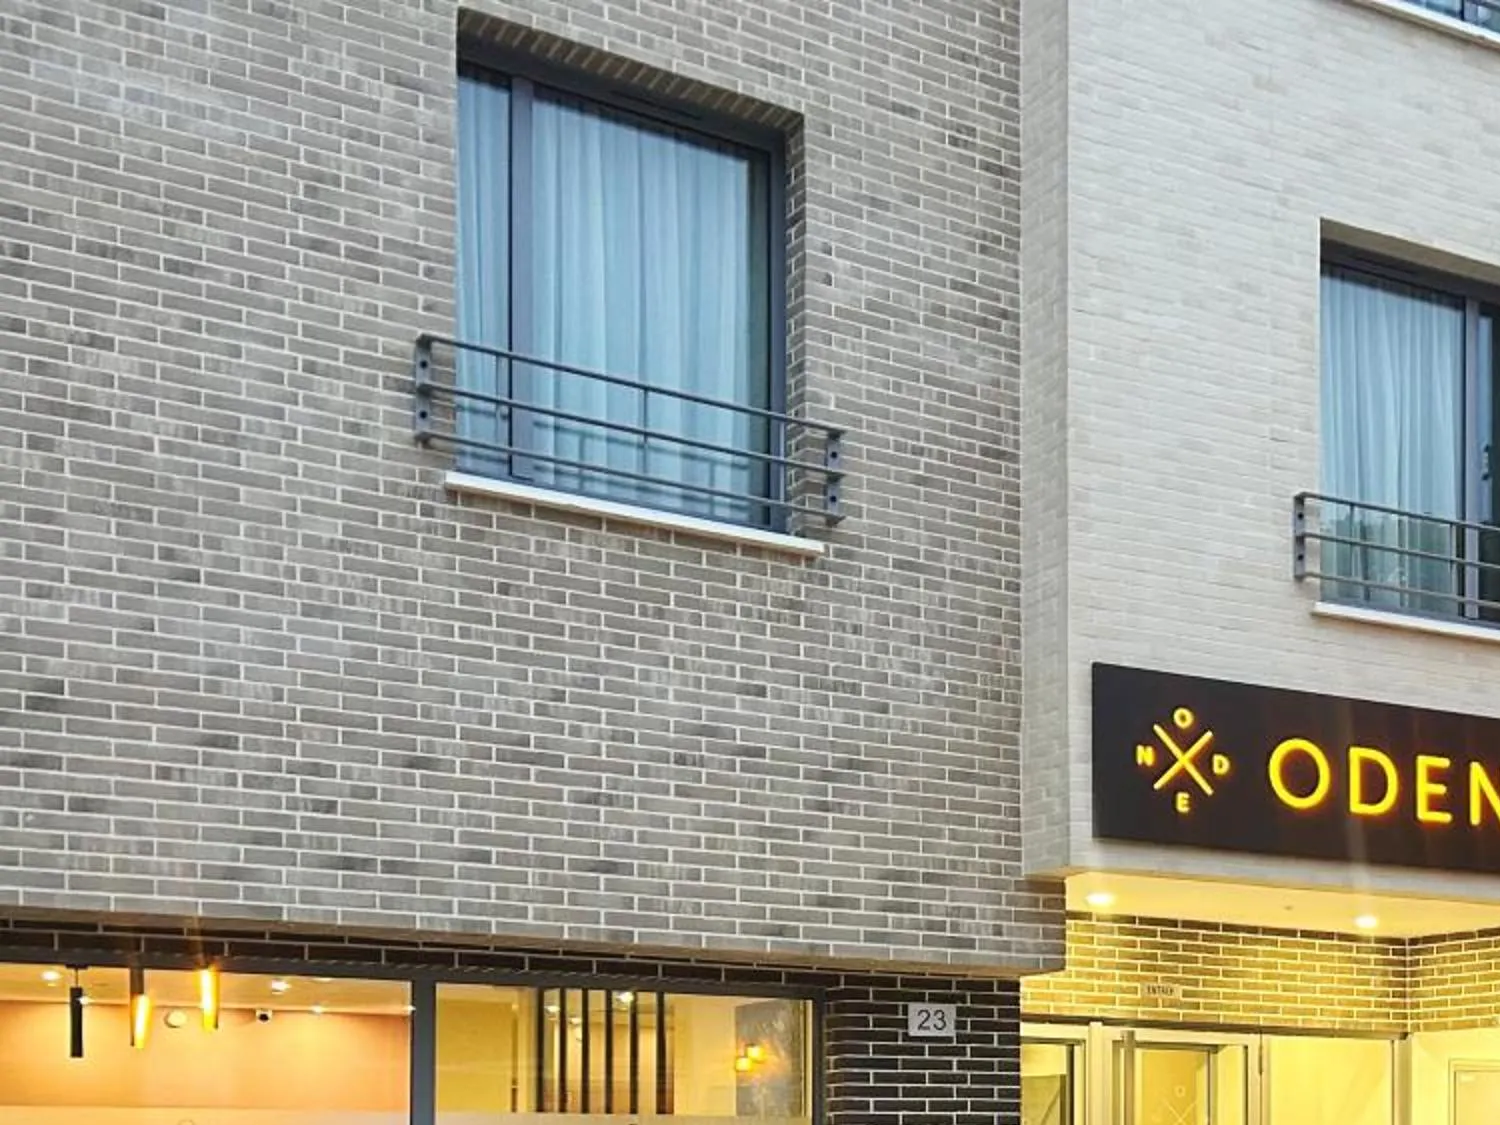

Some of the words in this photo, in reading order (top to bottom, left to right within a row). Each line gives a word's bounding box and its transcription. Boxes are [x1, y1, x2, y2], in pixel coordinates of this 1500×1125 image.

[1173, 707, 1195, 730] O
[1135, 743, 1156, 767] N
[1212, 753, 1231, 776] D
[1175, 791, 1191, 814] E
[916, 1008, 947, 1031] 23
